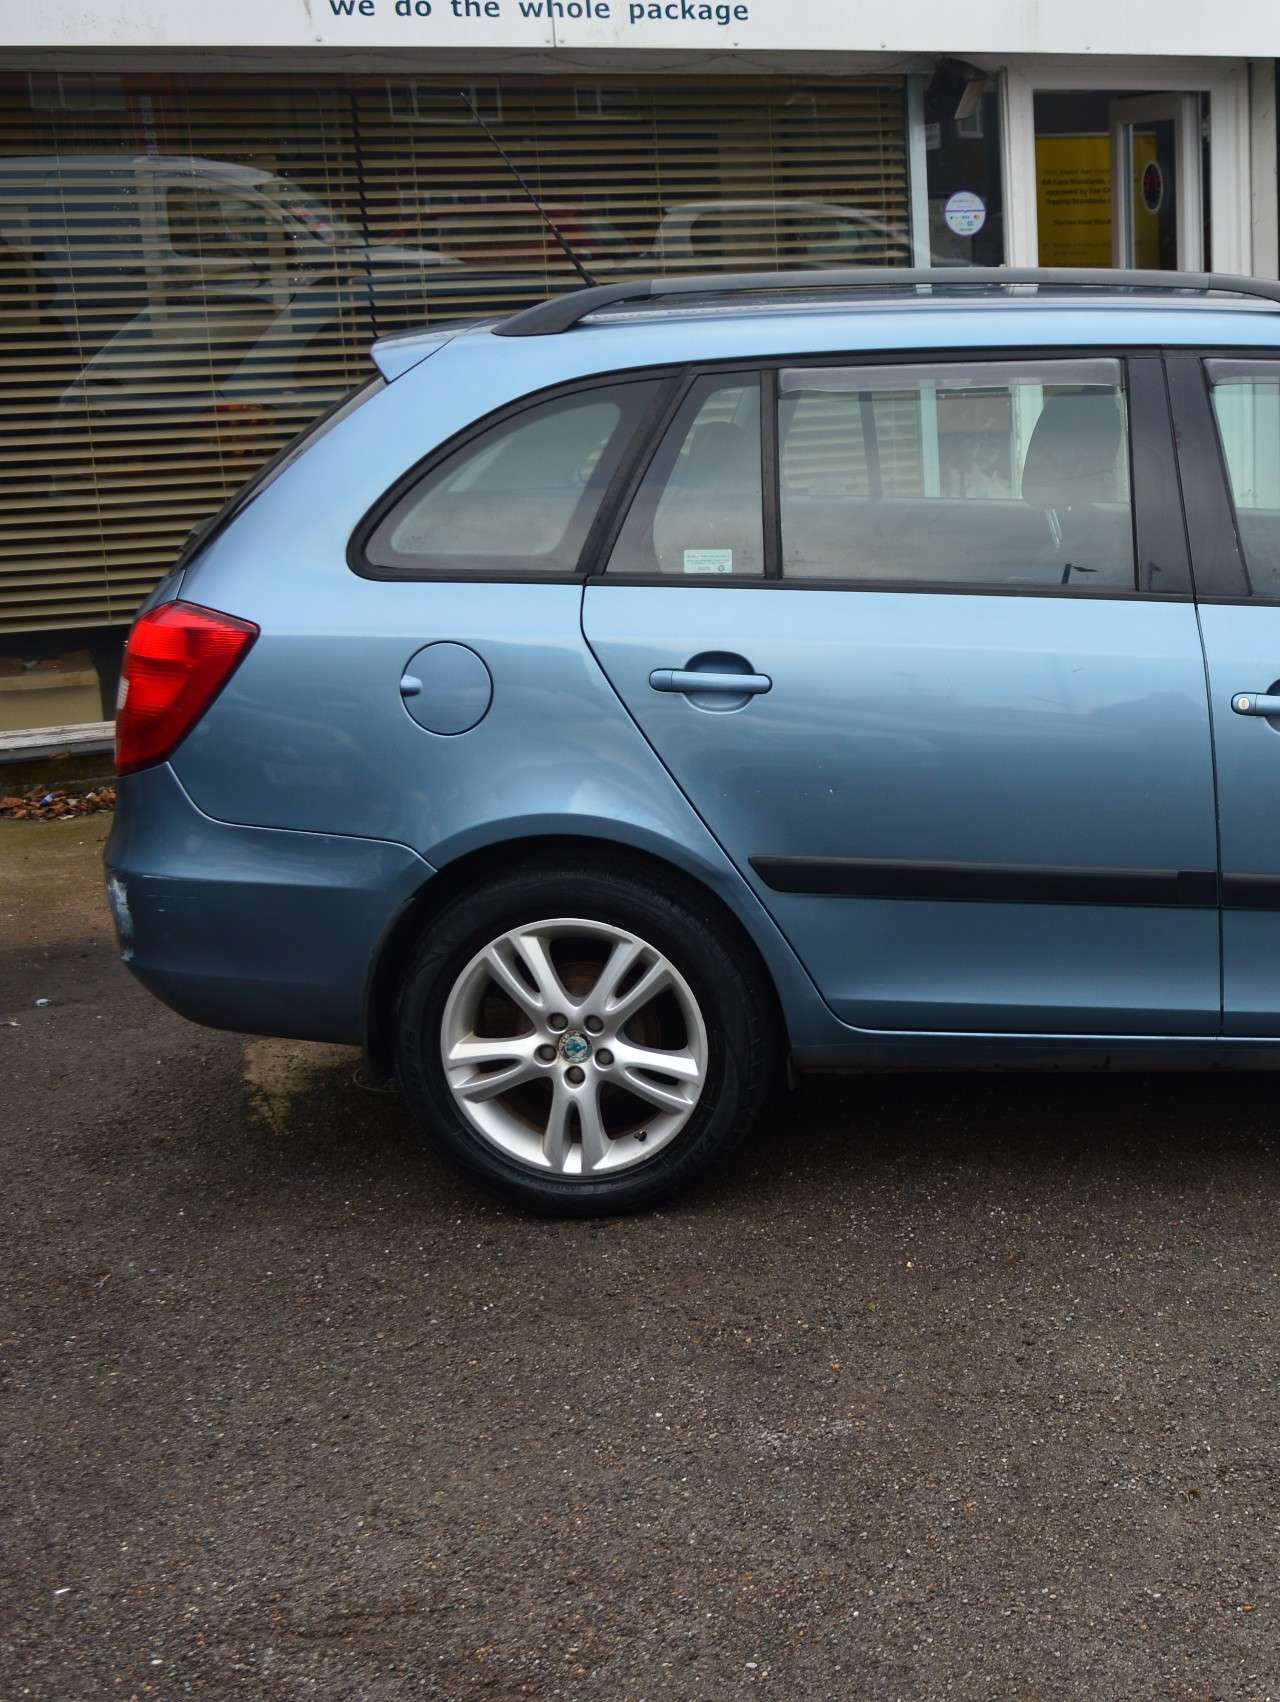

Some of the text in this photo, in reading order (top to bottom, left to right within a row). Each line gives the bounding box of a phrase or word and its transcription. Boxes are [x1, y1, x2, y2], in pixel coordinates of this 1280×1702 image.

[330, 0, 749, 25] we do the whole package
